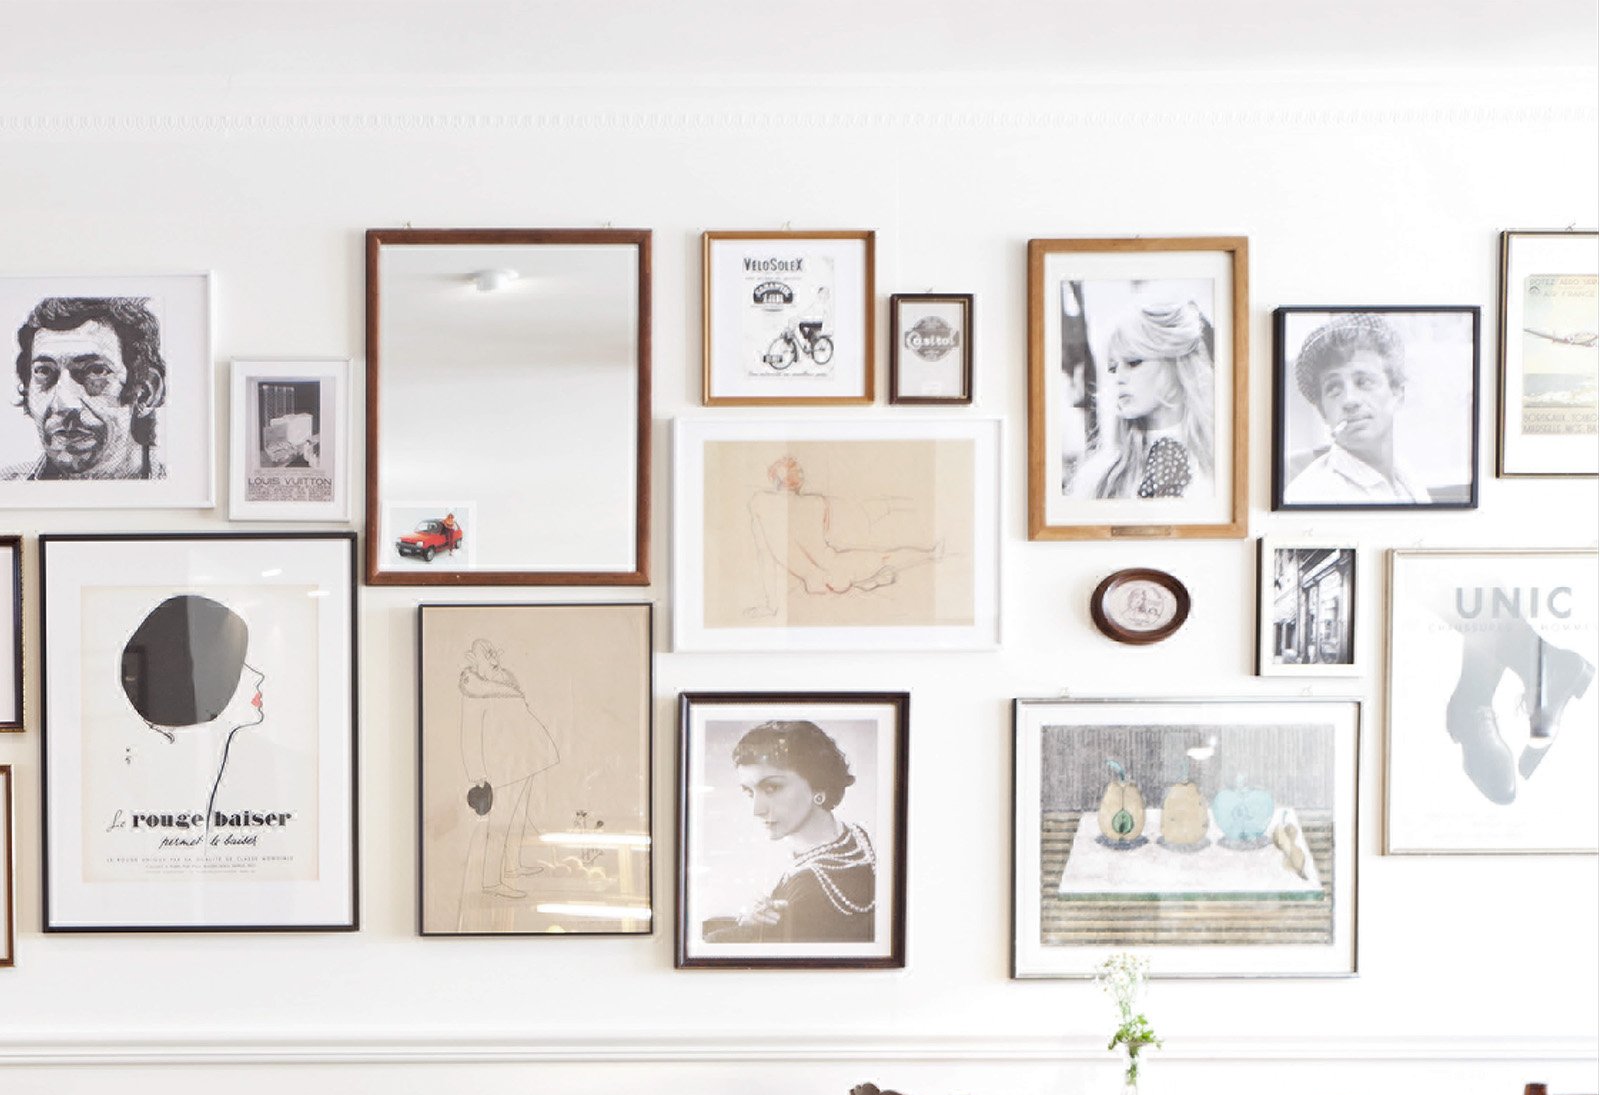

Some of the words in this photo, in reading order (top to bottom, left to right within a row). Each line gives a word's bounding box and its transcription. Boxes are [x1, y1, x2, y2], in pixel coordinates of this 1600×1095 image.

[1455, 586, 1573, 619] UNIC
[132, 812, 204, 830] rouge
[214, 810, 292, 828] baiser
